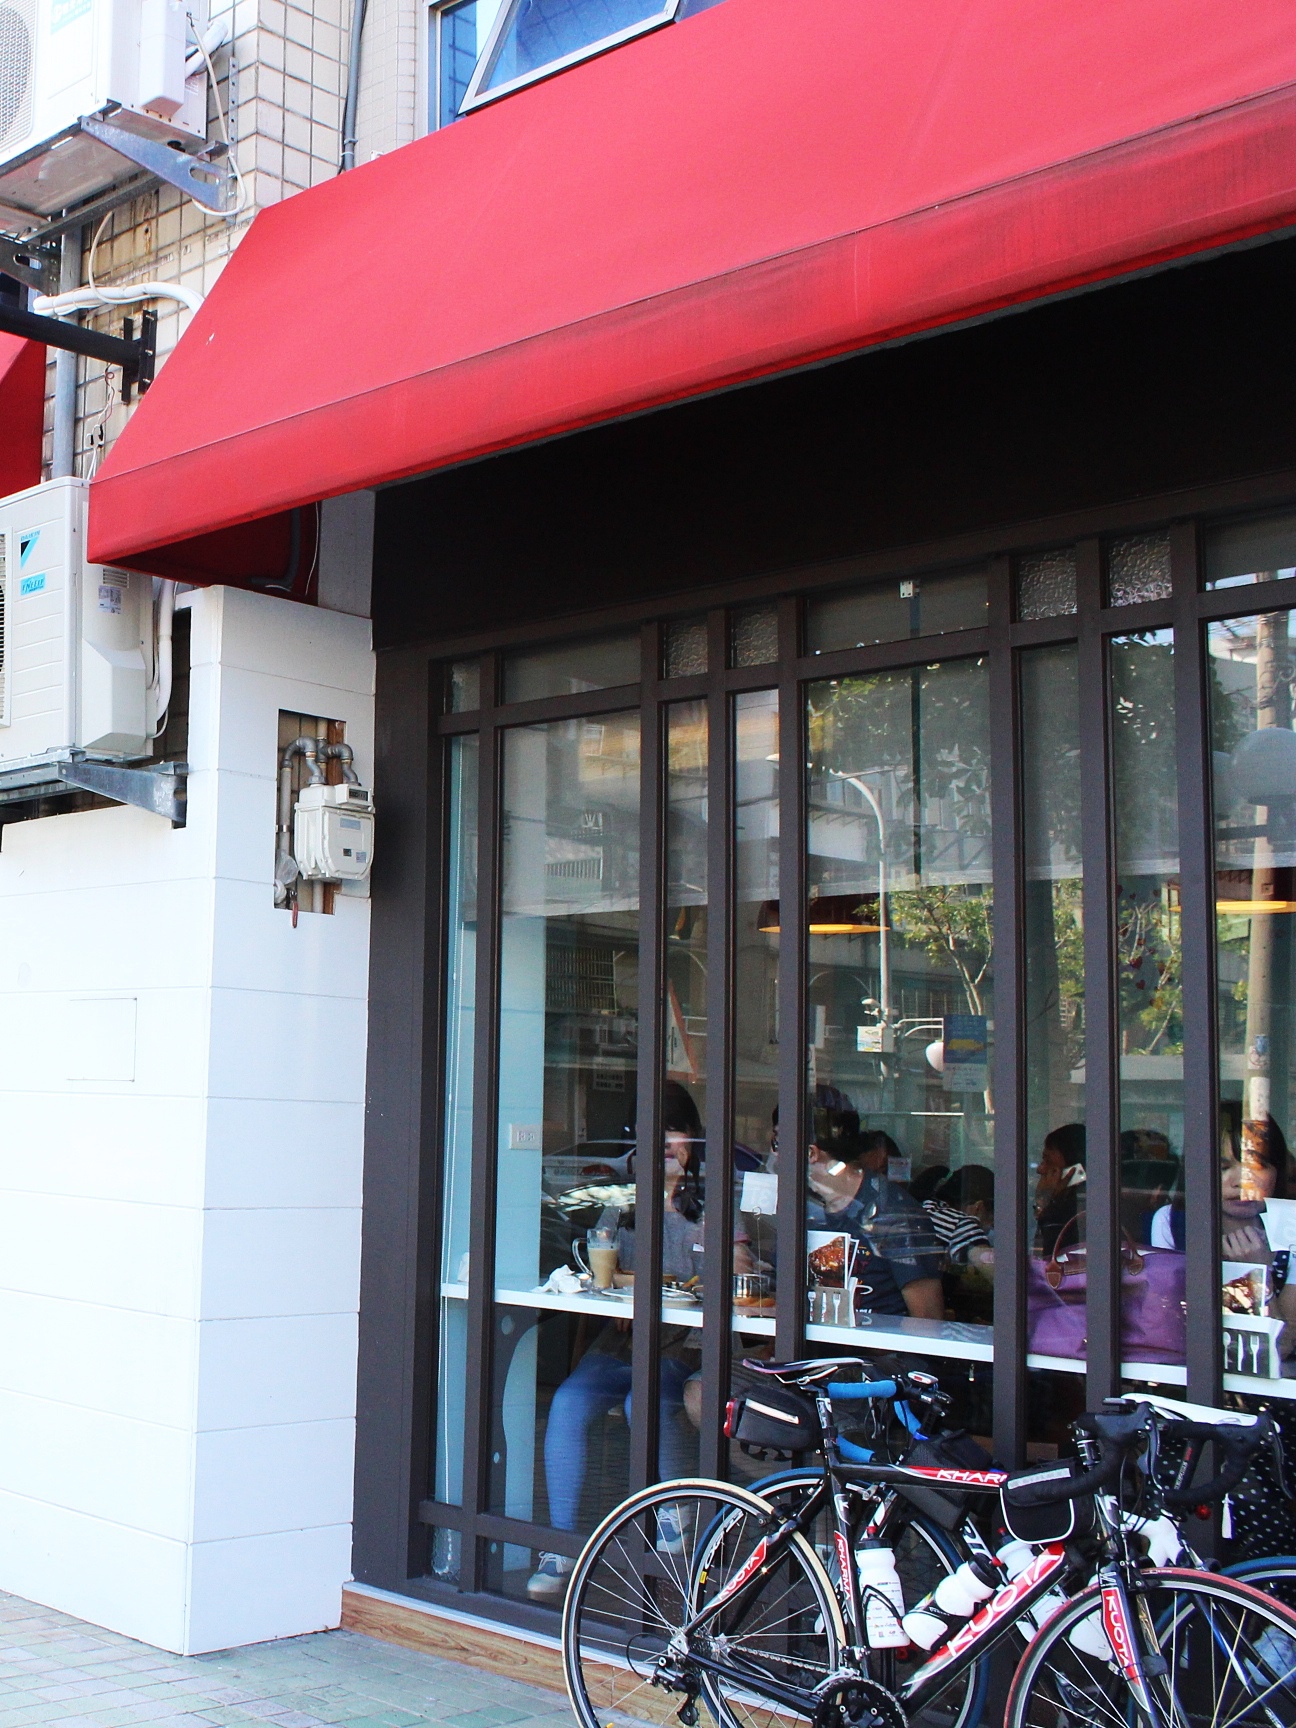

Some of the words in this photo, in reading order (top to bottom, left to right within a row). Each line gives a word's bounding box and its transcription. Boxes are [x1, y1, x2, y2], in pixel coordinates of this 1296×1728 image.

[836, 1538, 851, 1600] KHARMA
[946, 1554, 1062, 1657] KUOTA
[1105, 1595, 1130, 1672] KUOTA
